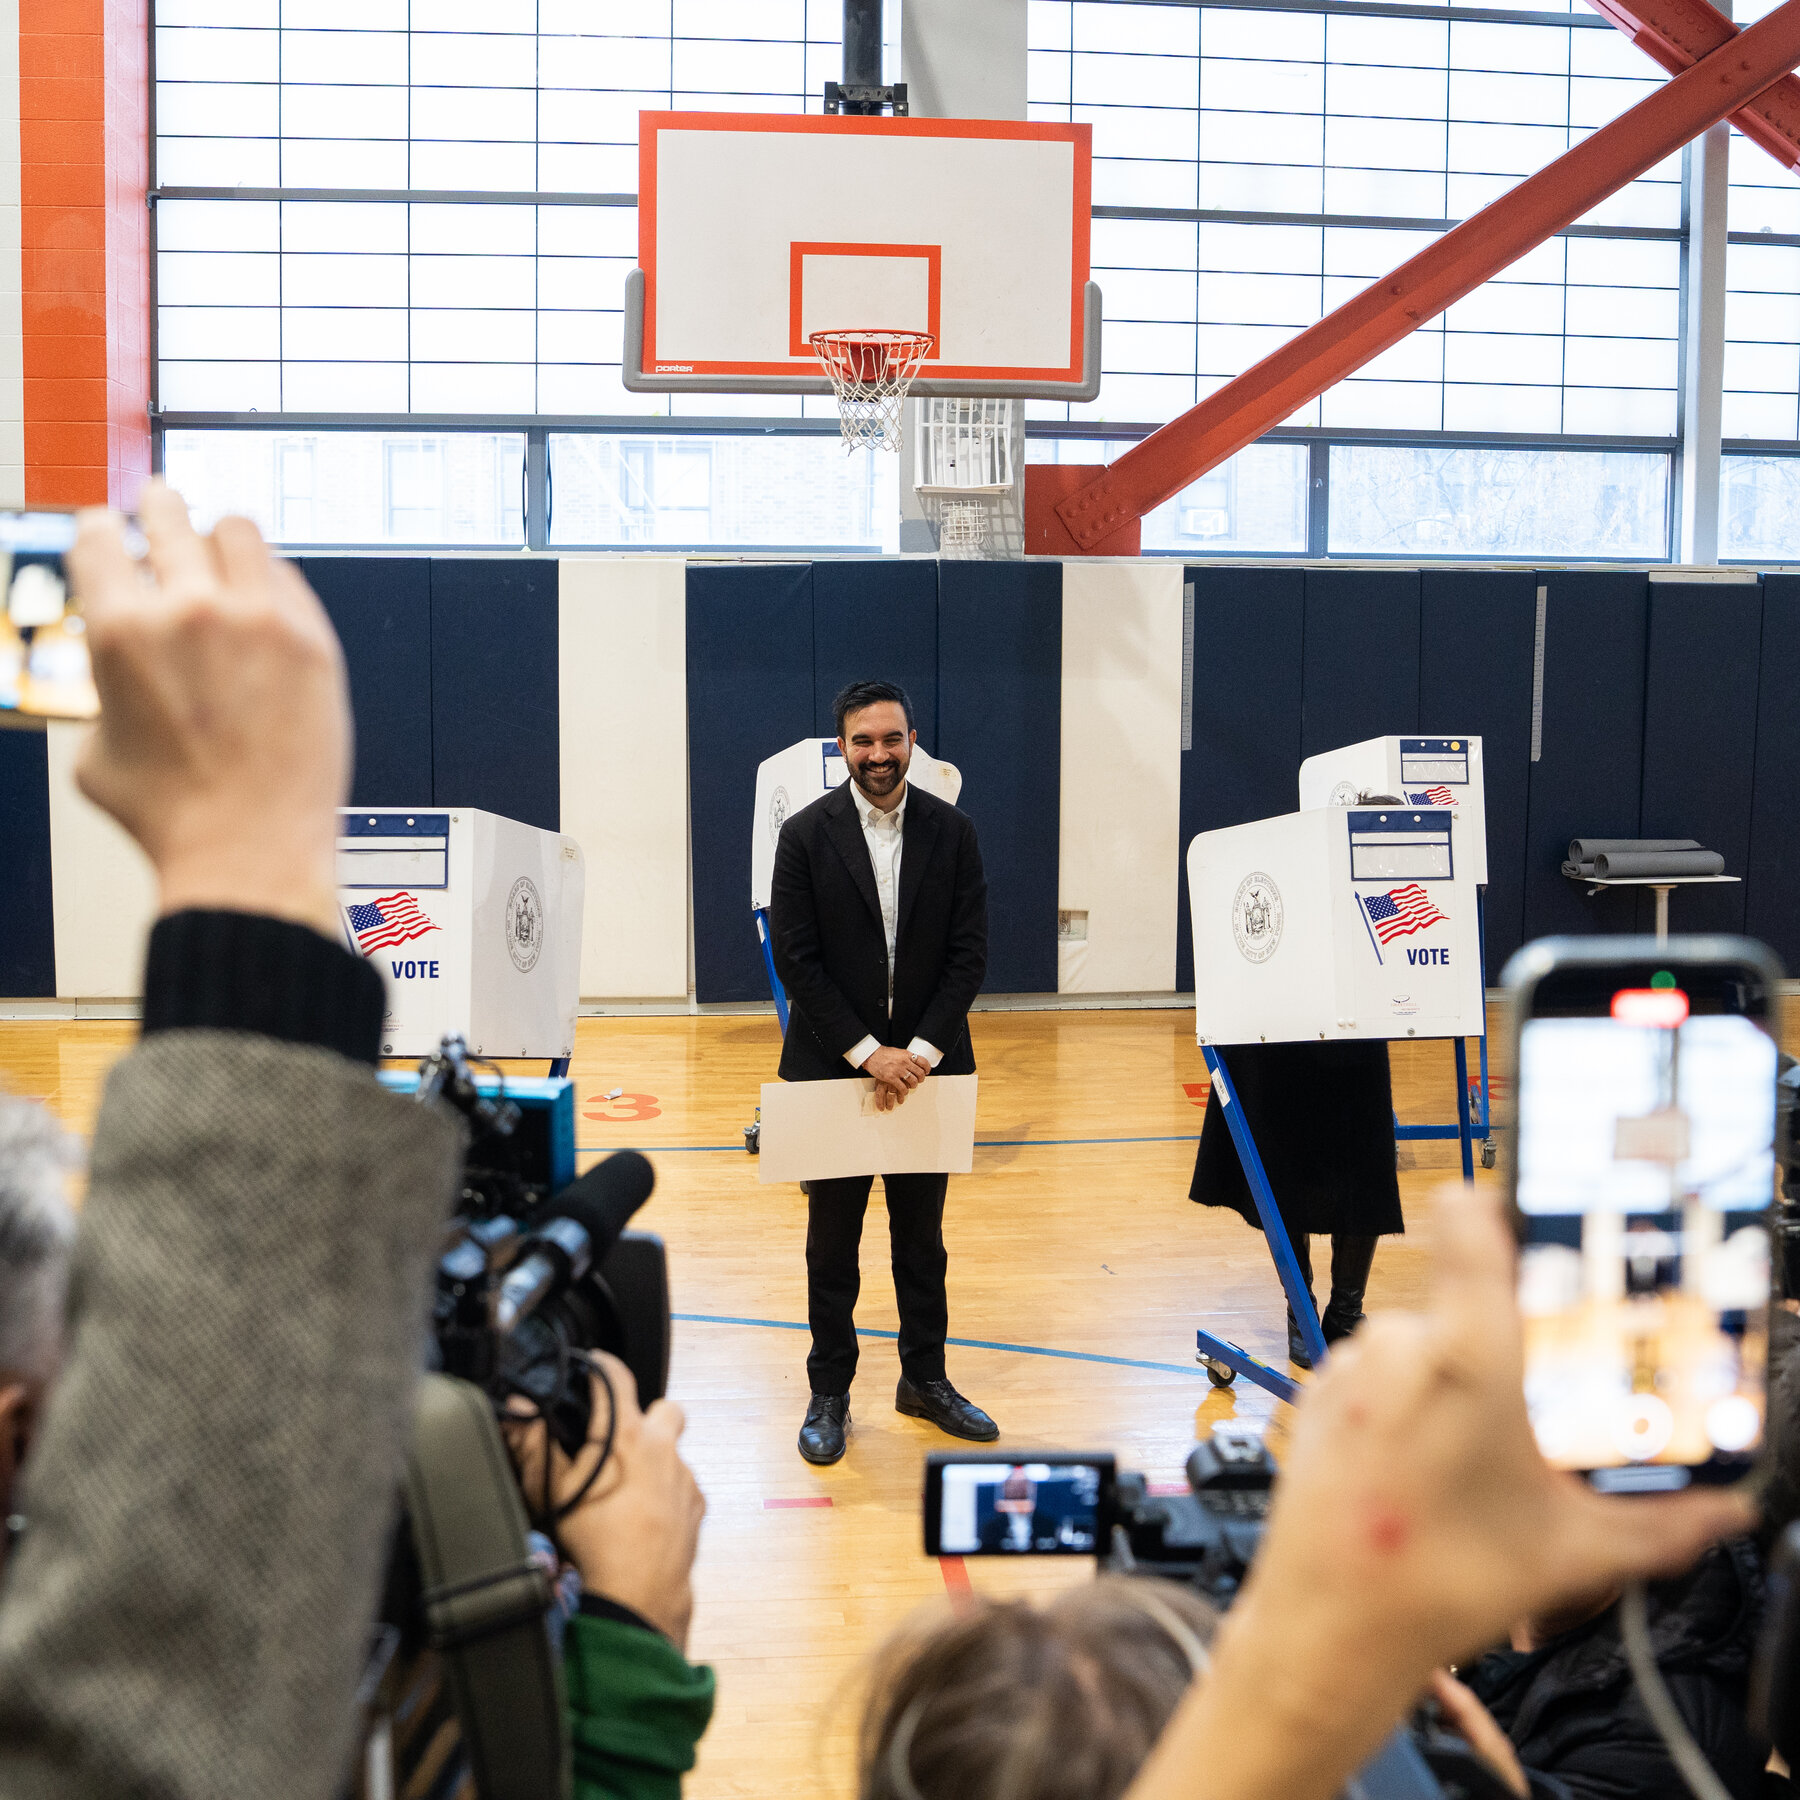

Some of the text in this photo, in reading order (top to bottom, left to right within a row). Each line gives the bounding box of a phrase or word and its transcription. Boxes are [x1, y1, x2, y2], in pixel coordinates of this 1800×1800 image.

[1407, 948, 1450, 966] VOTE
[391, 960, 440, 979] VOTE
[582, 1093, 662, 1122] 3
